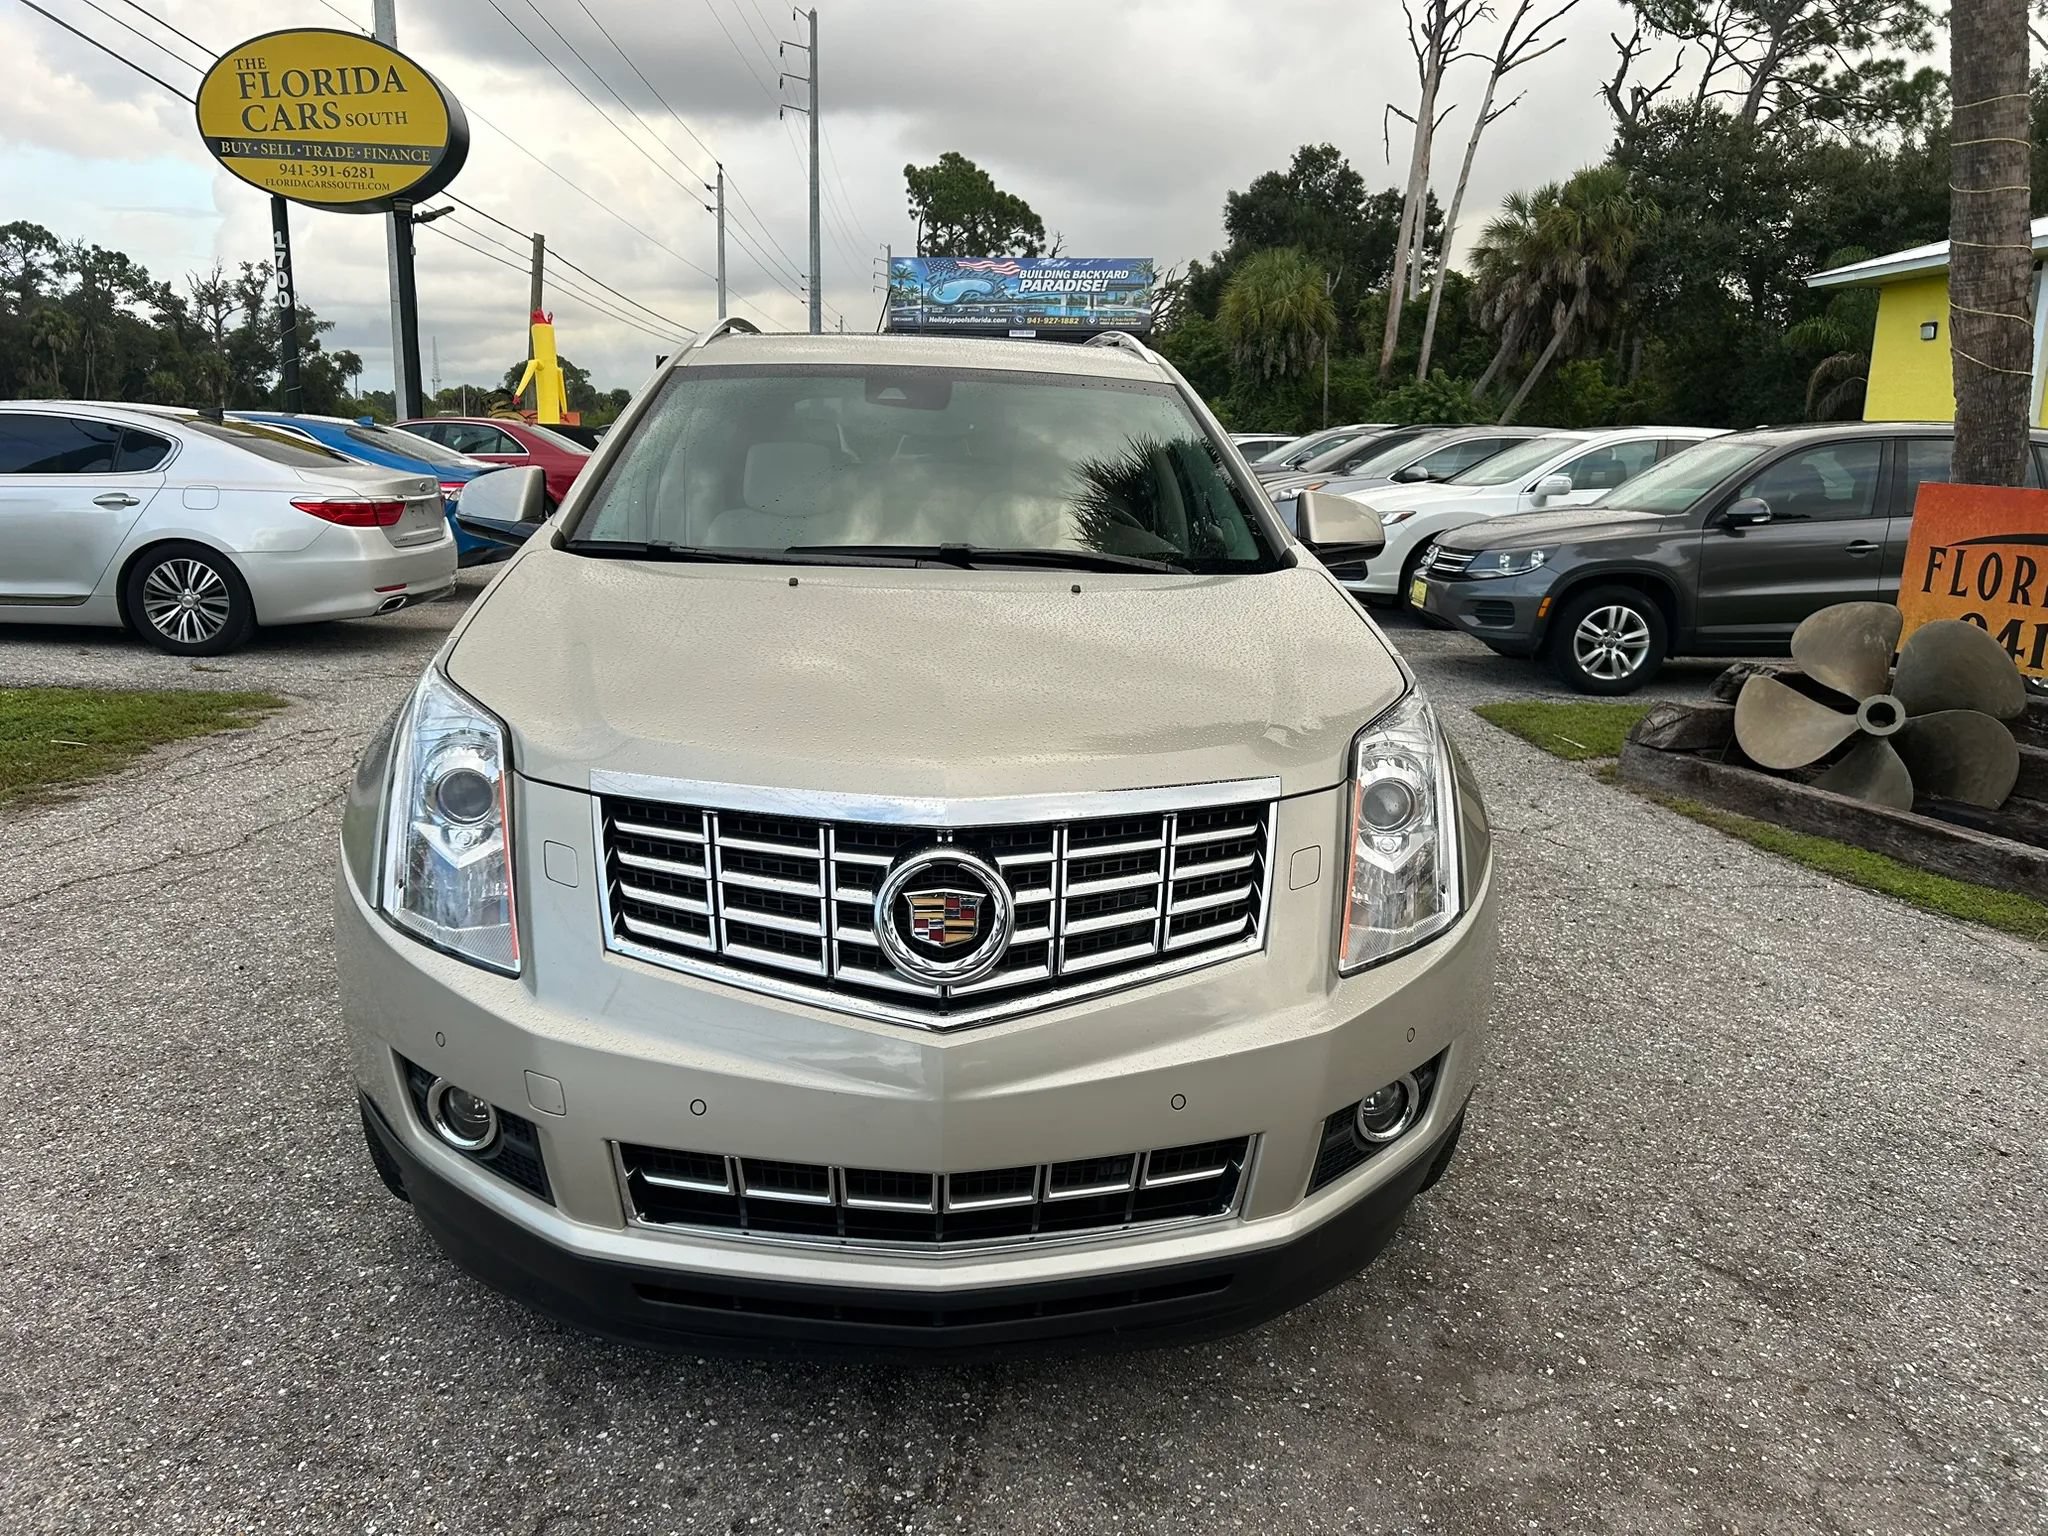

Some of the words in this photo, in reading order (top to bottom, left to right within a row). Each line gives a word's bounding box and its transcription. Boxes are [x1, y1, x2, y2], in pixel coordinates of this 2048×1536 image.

[234, 57, 267, 70] THE
[236, 64, 408, 100] FLORIDA
[241, 101, 341, 133] CARS
[345, 111, 408, 127] SOUTH
[220, 141, 253, 154] BUY
[260, 143, 295, 156] SELL
[301, 145, 355, 159] TRADE
[364, 147, 430, 162] FINANCE
[279, 163, 375, 179] 941-391-6281
[265, 178, 390, 191] FLORIDACARSSOUTH.COM
[274, 230, 290, 308] 1700
[1019, 270, 1071, 280] BUILDING
[1072, 270, 1129, 280] BACKYARD
[1019, 279, 1109, 292] PARADISE!
[1026, 316, 1079, 325] 941-927-1882
[1921, 546, 2048, 609] FLOR
